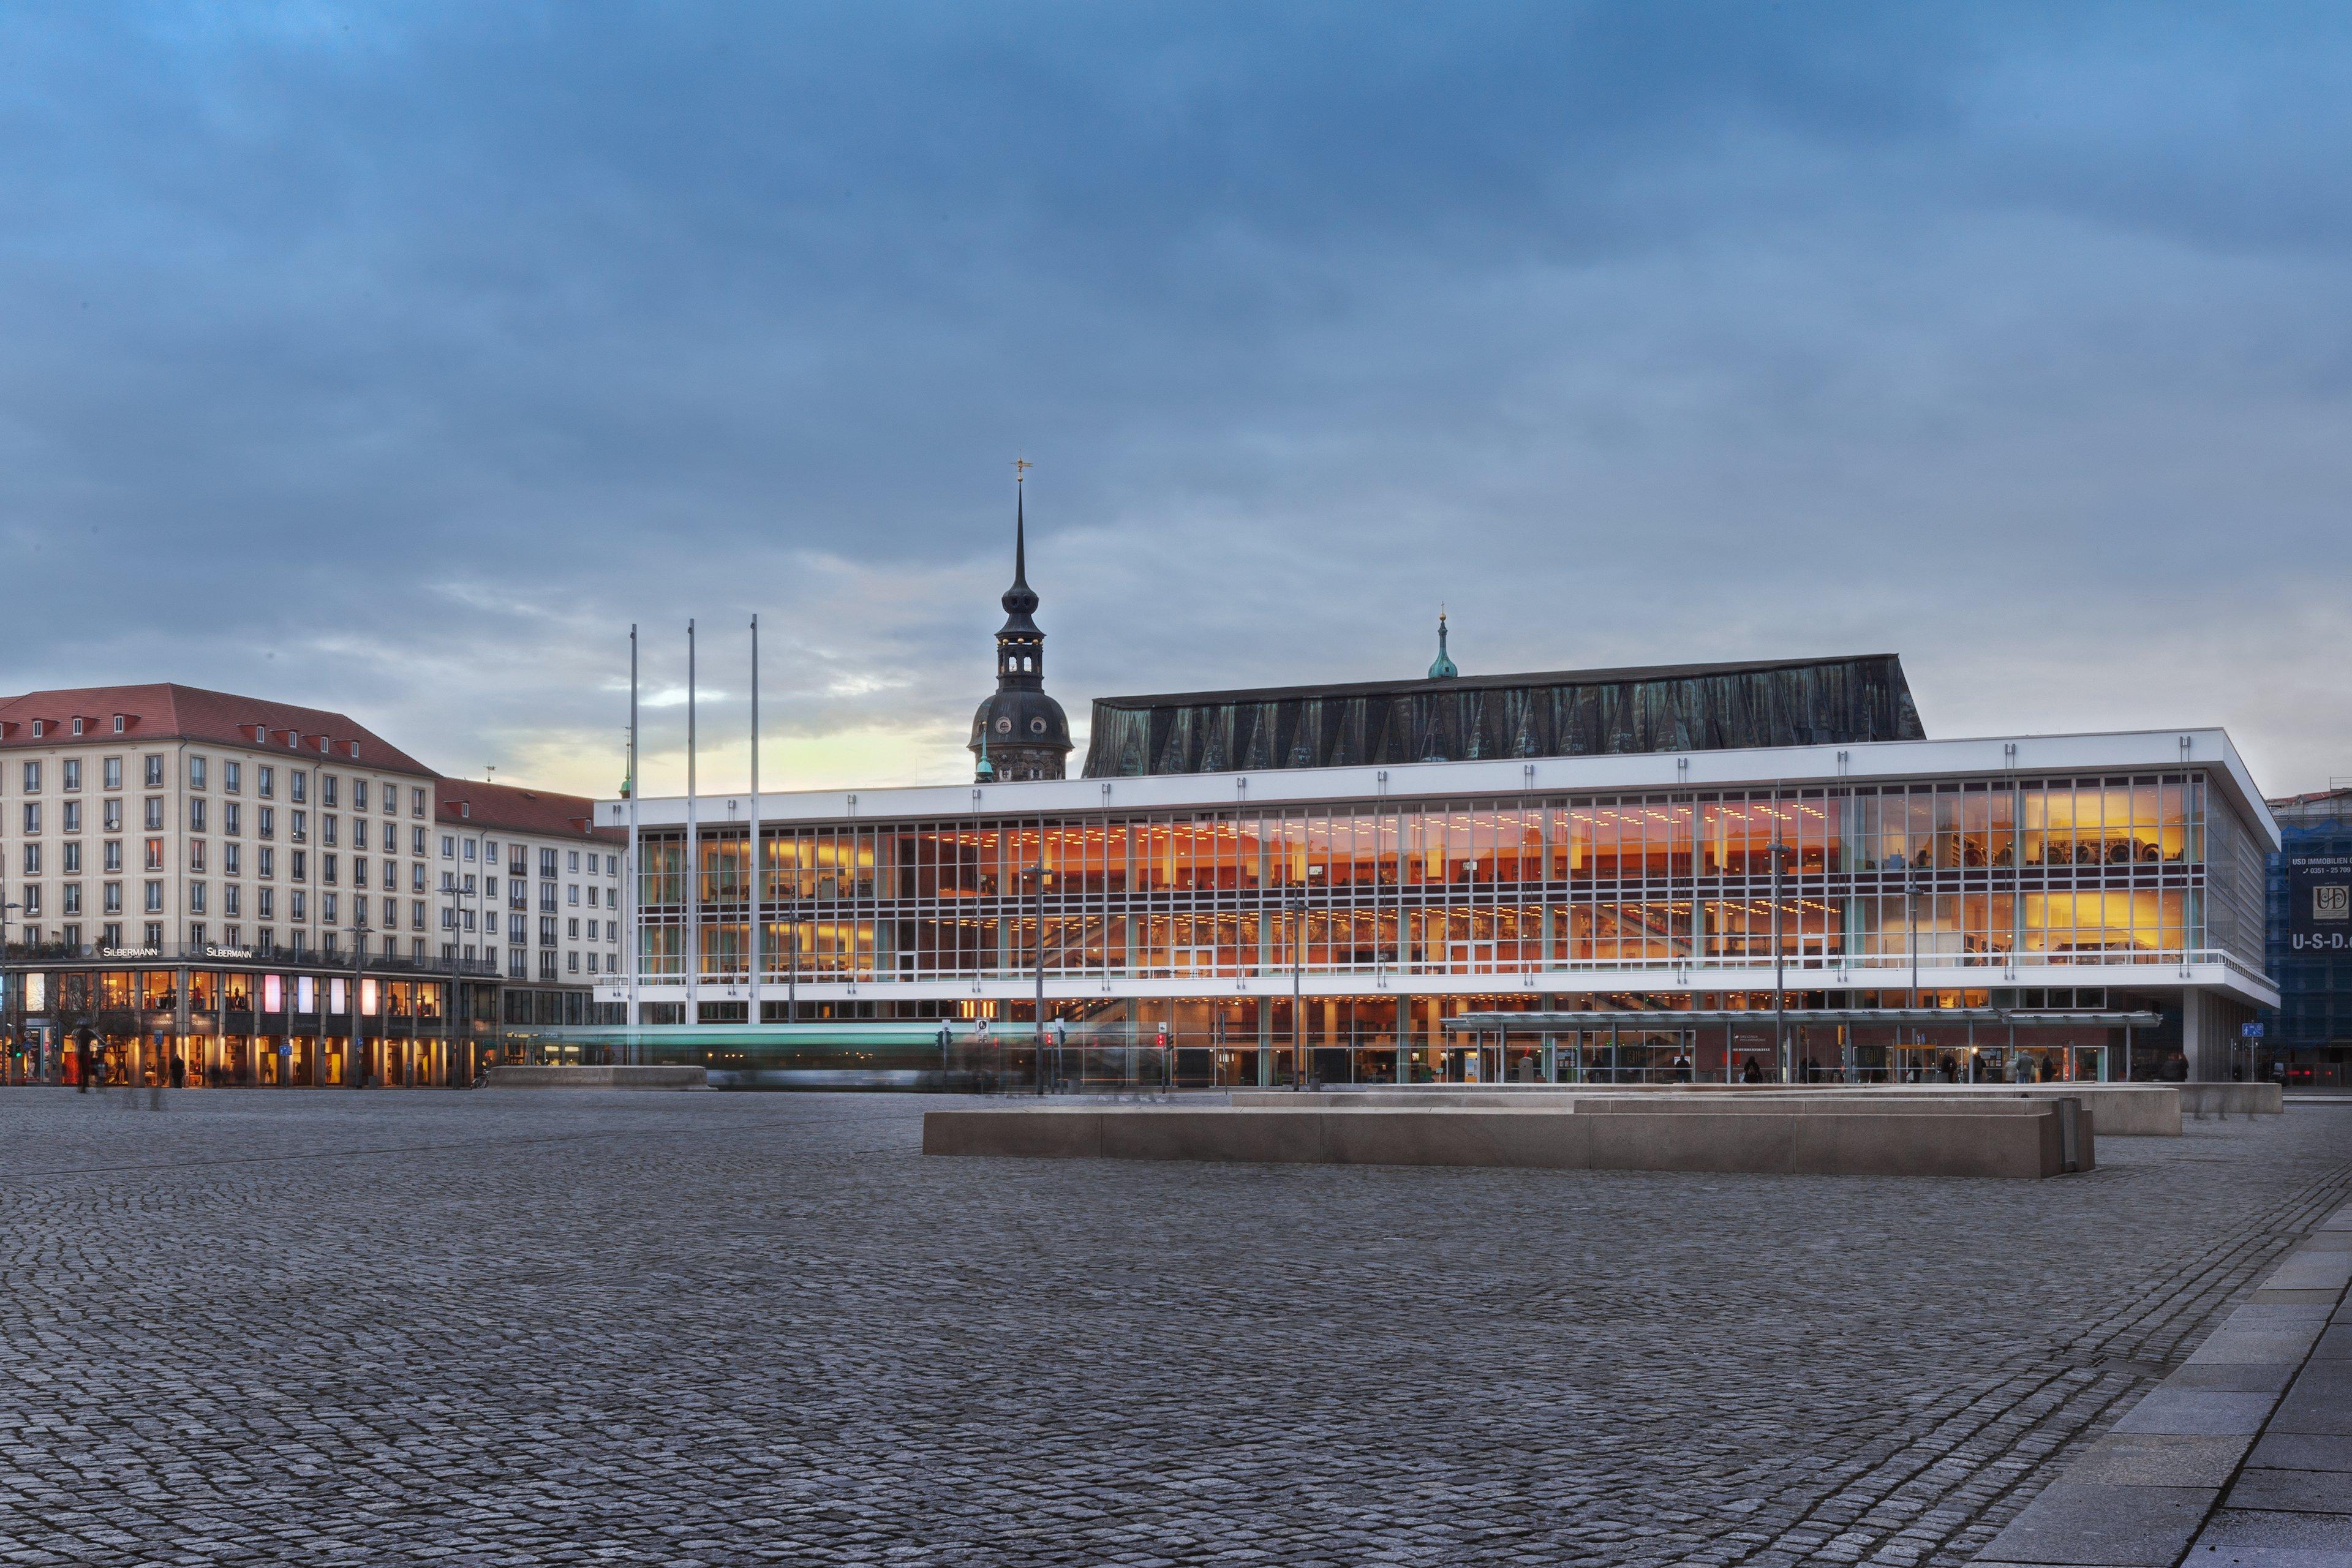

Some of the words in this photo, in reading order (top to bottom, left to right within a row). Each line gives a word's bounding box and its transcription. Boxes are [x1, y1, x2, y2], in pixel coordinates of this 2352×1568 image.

[2293, 933, 2352, 949] U-S-D.
[104, 947, 157, 957] SILBERMANN
[206, 947, 252, 958] SILBERMANN
